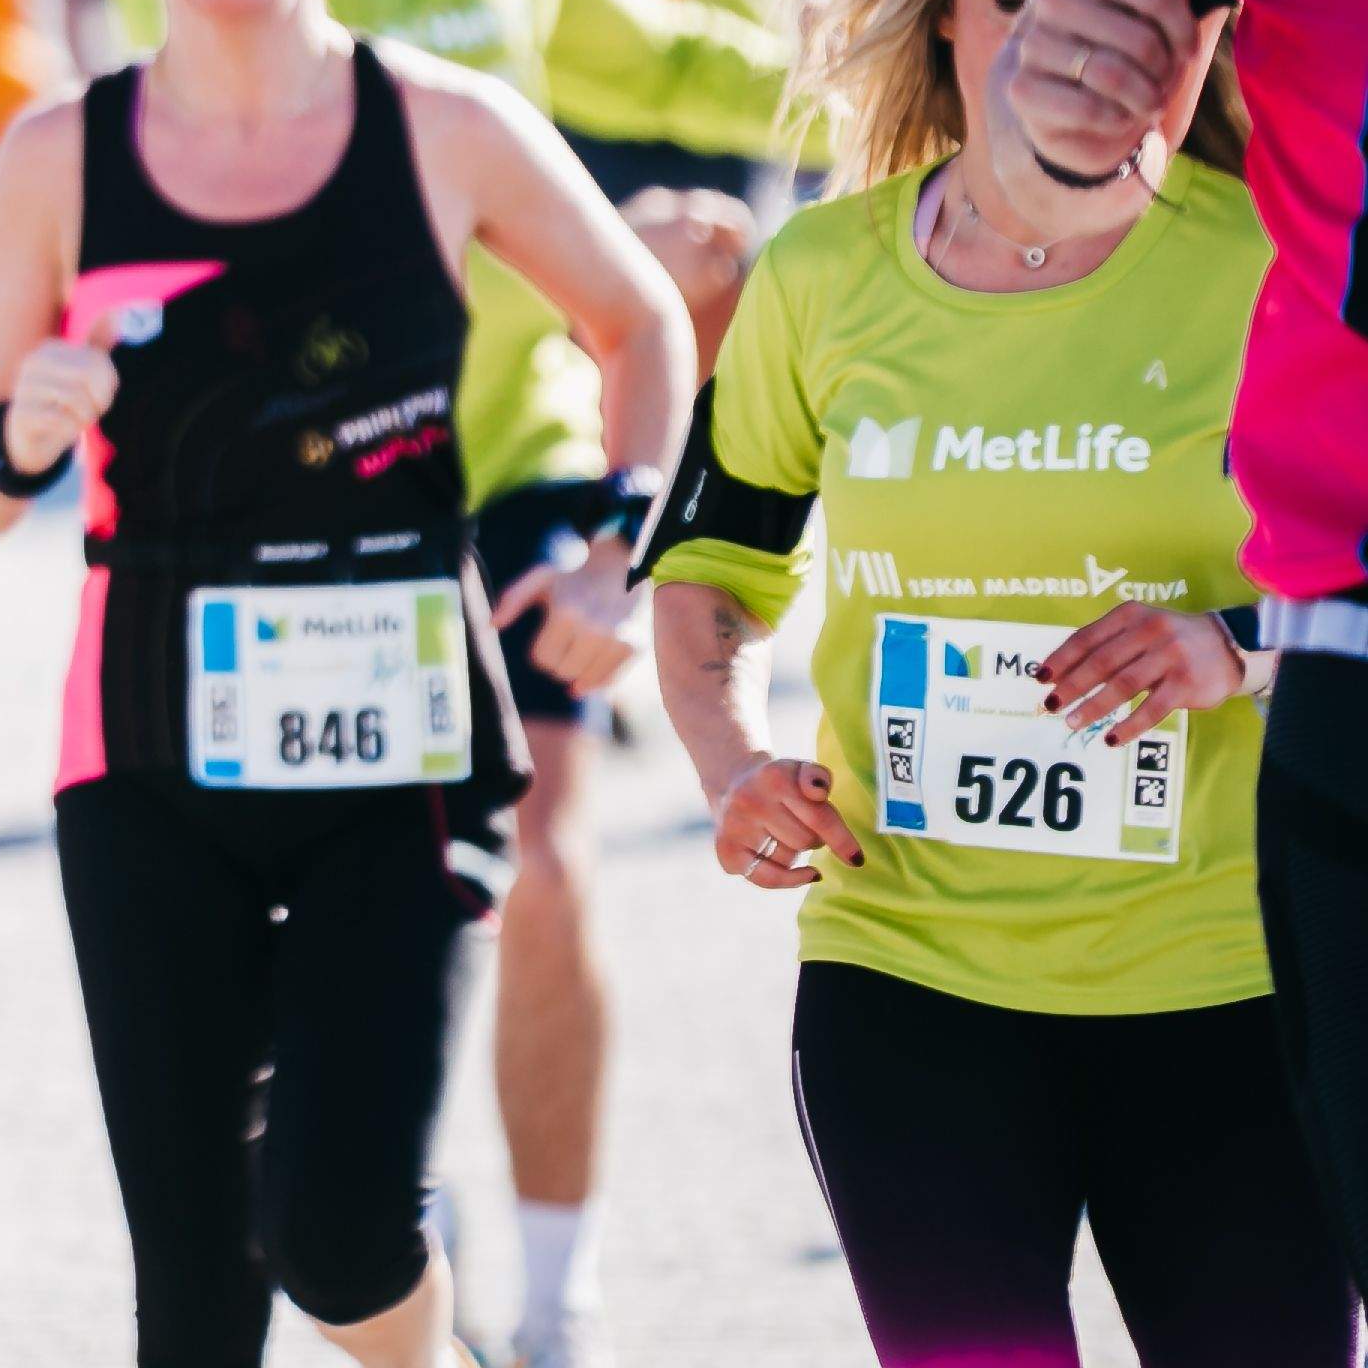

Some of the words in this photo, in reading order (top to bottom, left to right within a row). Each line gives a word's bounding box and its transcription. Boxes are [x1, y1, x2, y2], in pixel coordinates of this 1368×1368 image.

[932, 420, 1152, 473] MetLife
[831, 548, 904, 600] VIII
[907, 577, 978, 599] 15KM
[277, 707, 387, 767] 846
[954, 753, 1087, 833] 526
